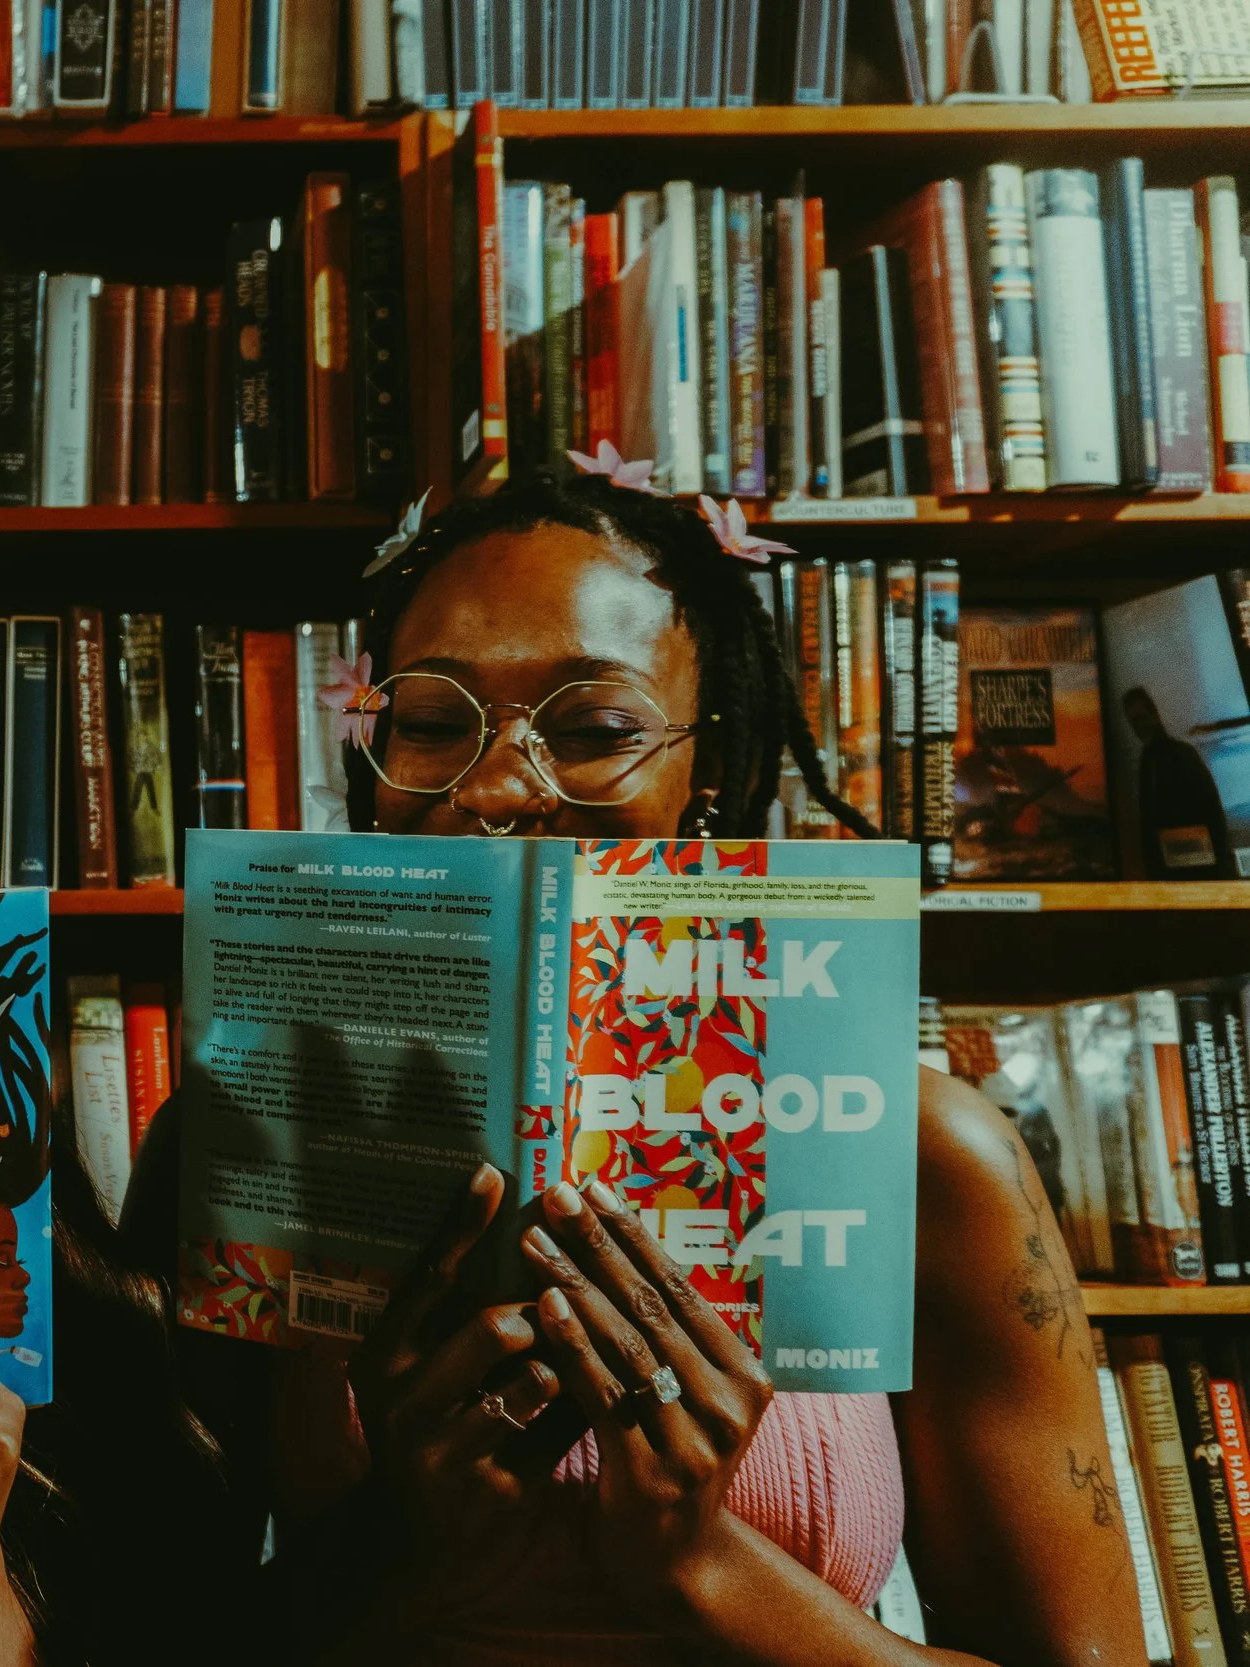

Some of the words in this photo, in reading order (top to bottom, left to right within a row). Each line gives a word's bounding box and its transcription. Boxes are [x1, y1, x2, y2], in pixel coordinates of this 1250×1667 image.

[1101, 0, 1163, 82] REEFE
[482, 224, 494, 248] The
[1168, 199, 1196, 296] Dharma
[236, 261, 253, 307] HEADS
[251, 249, 268, 318] CROWNED
[482, 252, 498, 331] Cannabible
[1173, 302, 1200, 359] Lion
[242, 376, 256, 423] TRYON
[256, 370, 270, 428] THOMAS
[942, 640, 958, 732] BERNARD
[923, 741, 942, 837] TRIUMPH
[232, 882, 253, 891] Blood
[255, 883, 274, 892] Heat
[277, 884, 284, 892] is
[293, 884, 328, 897] seething
[331, 888, 376, 897] excavation
[379, 888, 389, 897] of
[391, 891, 413, 899] want
[415, 891, 432, 900] and
[434, 892, 465, 901] human
[468, 895, 493, 903] error.
[249, 863, 278, 872] Praise
[280, 864, 295, 873] for
[298, 864, 334, 874] MILK
[341, 865, 394, 877] BLOOD
[401, 867, 449, 880] HEAT
[540, 866, 559, 924] MILK
[630, 892, 669, 900] devastating
[674, 882, 691, 890] sings
[732, 882, 765, 890] girlhood,
[214, 893, 242, 902] Moniz
[245, 894, 275, 904] writes
[278, 896, 308, 906] about
[311, 898, 328, 907] the
[332, 899, 355, 908] hard
[359, 900, 427, 914] incongruities
[430, 904, 442, 912] of
[445, 905, 491, 917] intimacy
[214, 905, 234, 913] with
[236, 907, 262, 917] great
[264, 909, 303, 920] urgency
[306, 910, 324, 919] and
[979, 895, 1028, 907] FICTION
[366, 927, 411, 937] LEILANI,
[413, 930, 447, 939] author
[449, 932, 460, 940] of
[462, 932, 491, 942] Luster
[537, 933, 556, 1015] BLOOD
[624, 940, 843, 998] MILK
[151, 1026, 168, 1089] Luncheon
[399, 1028, 440, 1040] EVANS,
[442, 1033, 476, 1043] author
[478, 1037, 489, 1045] of
[534, 1024, 553, 1096] HEAT
[83, 1069, 104, 1105] List
[1195, 1019, 1222, 1115] ALEXANDER
[580, 1074, 886, 1134] BLOOD
[532, 1148, 547, 1195] DAN
[1205, 1113, 1233, 1208] FULLERTON
[709, 1302, 760, 1313] TORIES
[776, 1348, 880, 1370] MONIZ
[1211, 1381, 1242, 1451] ROBERT
[1207, 1476, 1236, 1544] ROBERT
[1115, 1476, 1144, 1548] ROBERT
[1131, 1552, 1162, 1624] HARRIS
[1220, 1547, 1250, 1616] HARRIS
